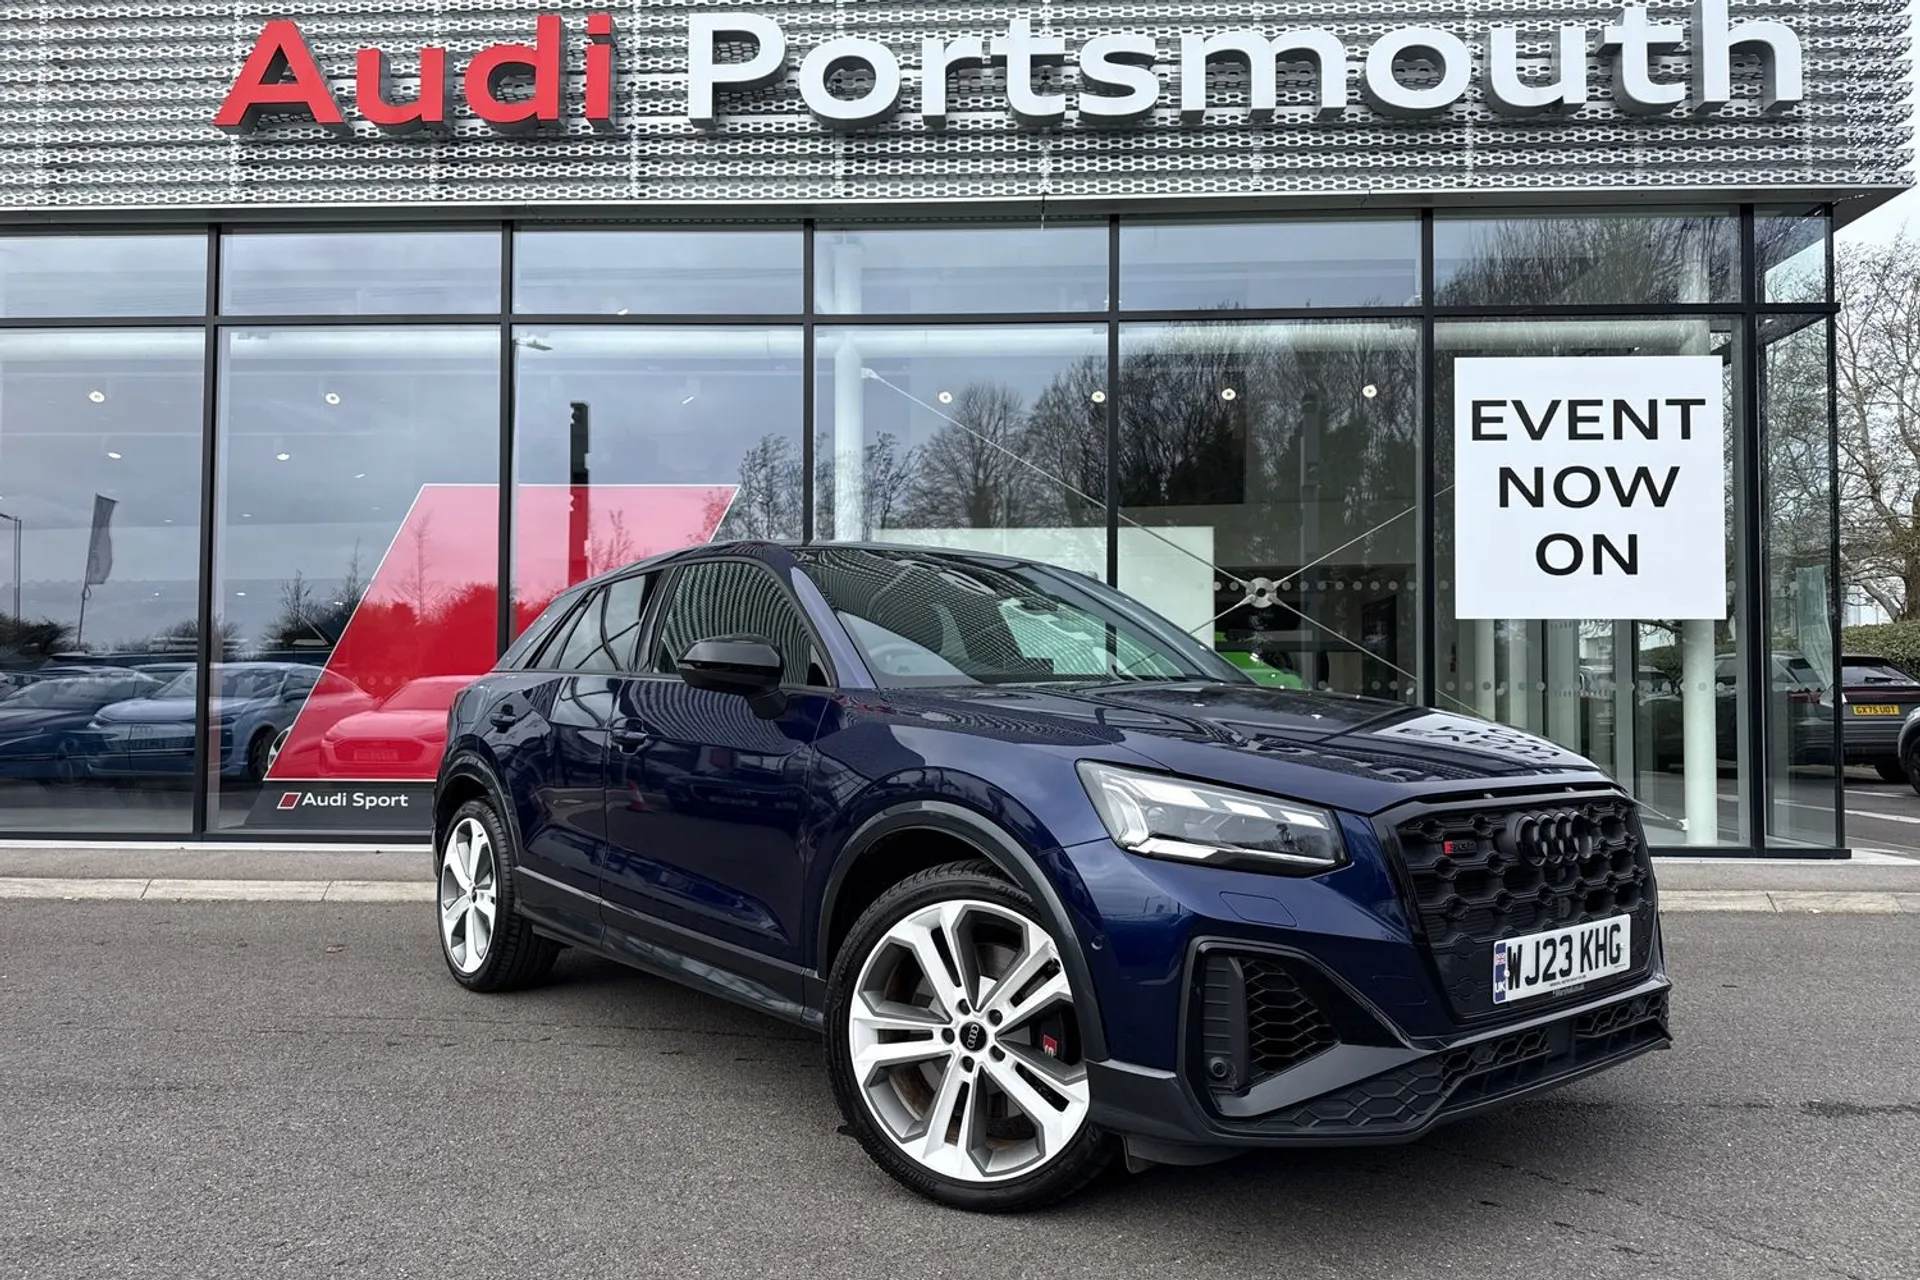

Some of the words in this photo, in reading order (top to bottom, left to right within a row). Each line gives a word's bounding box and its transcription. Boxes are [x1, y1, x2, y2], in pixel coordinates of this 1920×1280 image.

[214, 14, 613, 126] Audi
[688, 0, 1803, 120] Portsmouth
[1471, 398, 1706, 441] EVENT
[1499, 465, 1680, 508] NOW
[1535, 532, 1638, 575] ON
[301, 792, 347, 806] Audi
[352, 793, 408, 809] Sport
[1507, 934, 1573, 991] WJ23
[1579, 923, 1621, 974] KHG
[1495, 980, 1506, 993] UK
